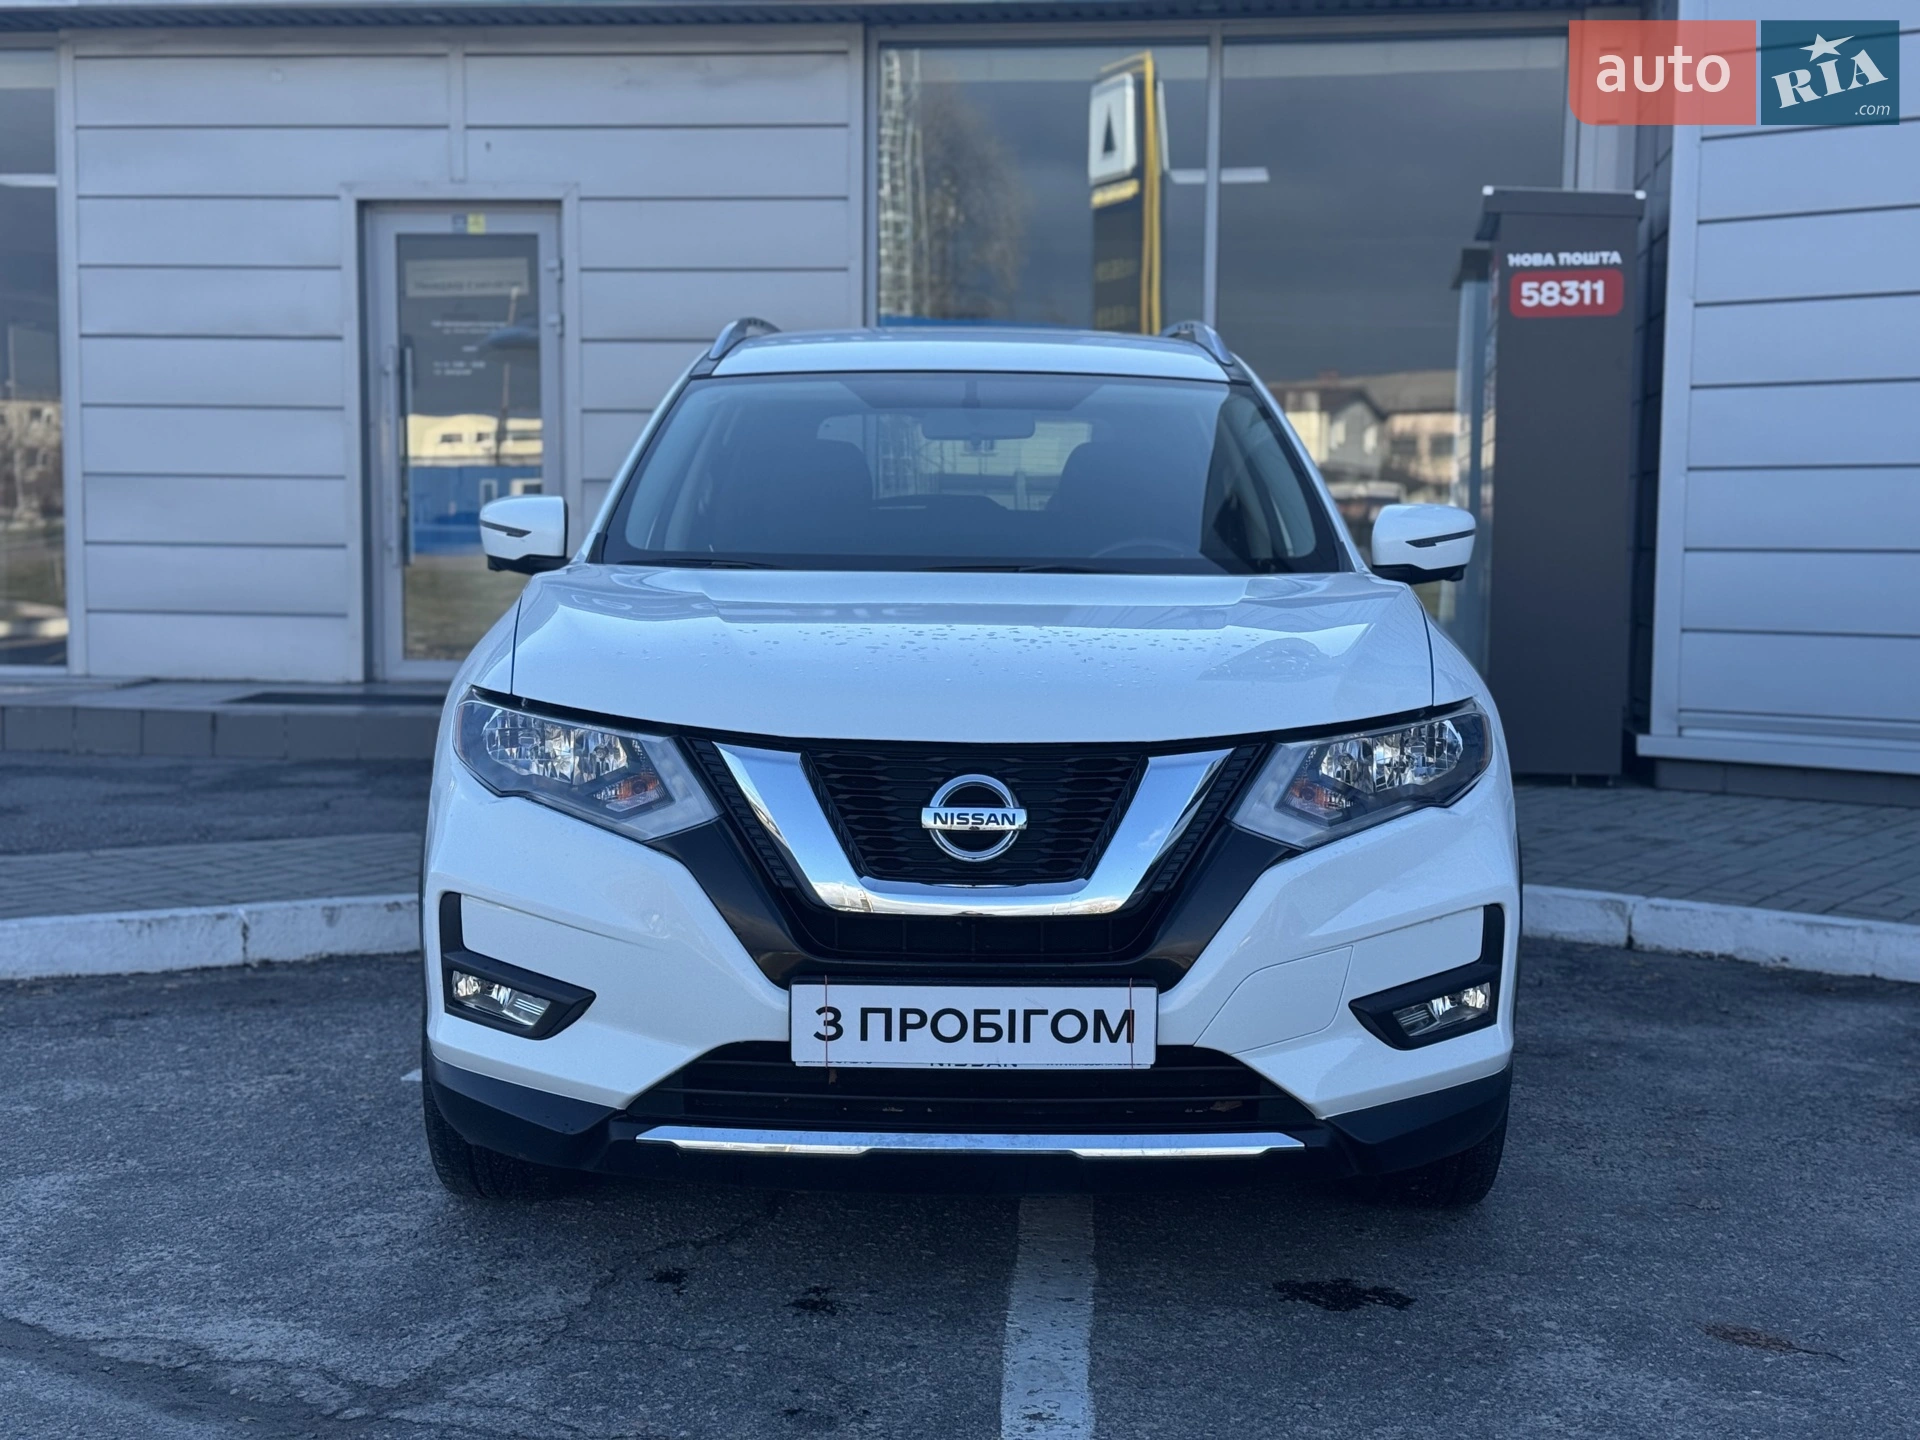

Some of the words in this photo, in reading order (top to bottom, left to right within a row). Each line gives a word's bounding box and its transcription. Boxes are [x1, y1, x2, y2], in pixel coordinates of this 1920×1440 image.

[1507, 253, 1555, 267] НОВА
[1557, 251, 1622, 266] ПОШТА
[1520, 279, 1605, 308] 58311
[933, 812, 1017, 826] NISSAN
[813, 1006, 844, 1042] З
[859, 1007, 1135, 1044] ПРОБІГОМ
